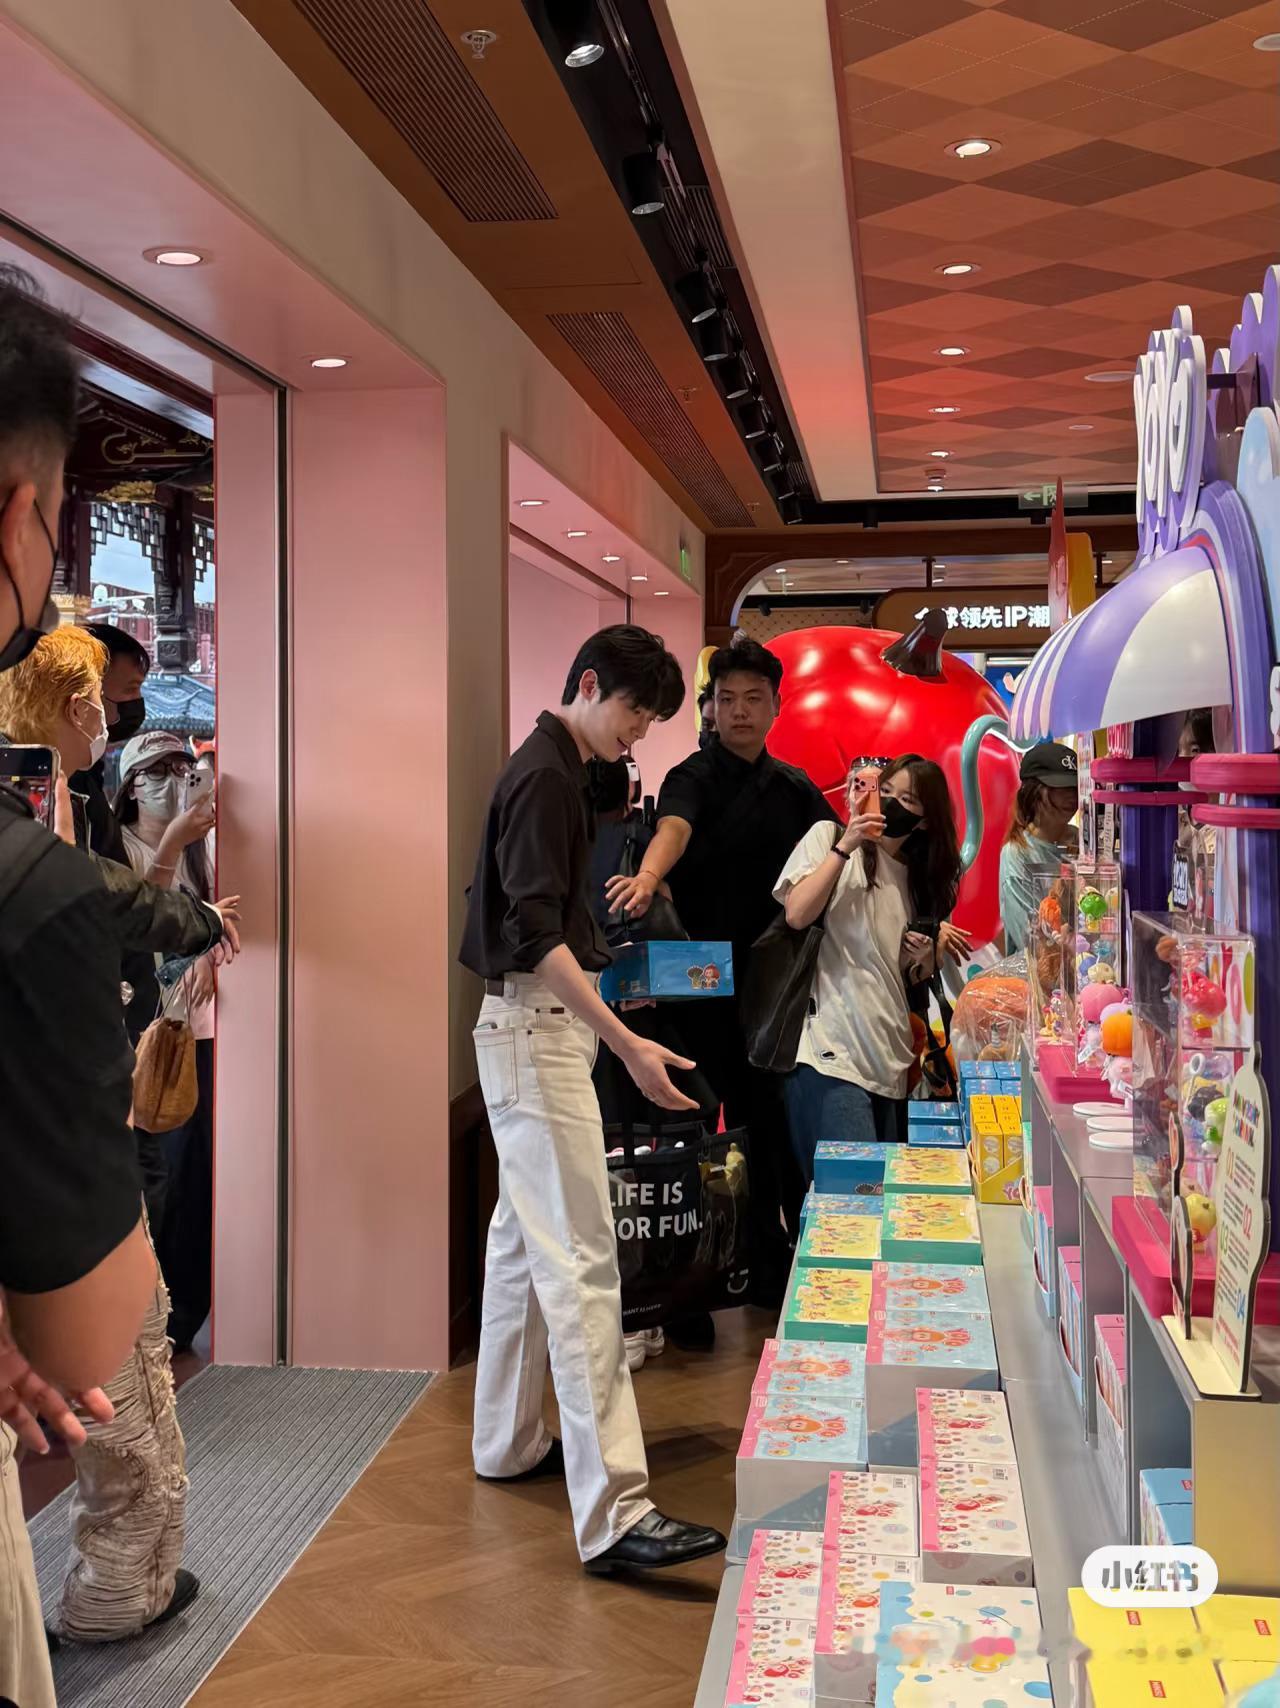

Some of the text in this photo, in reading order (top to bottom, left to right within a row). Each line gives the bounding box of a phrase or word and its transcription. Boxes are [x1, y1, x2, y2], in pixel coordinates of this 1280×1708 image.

[611, 1181, 683, 1207] IFE IS
[613, 1208, 703, 1241] OR FUN.
